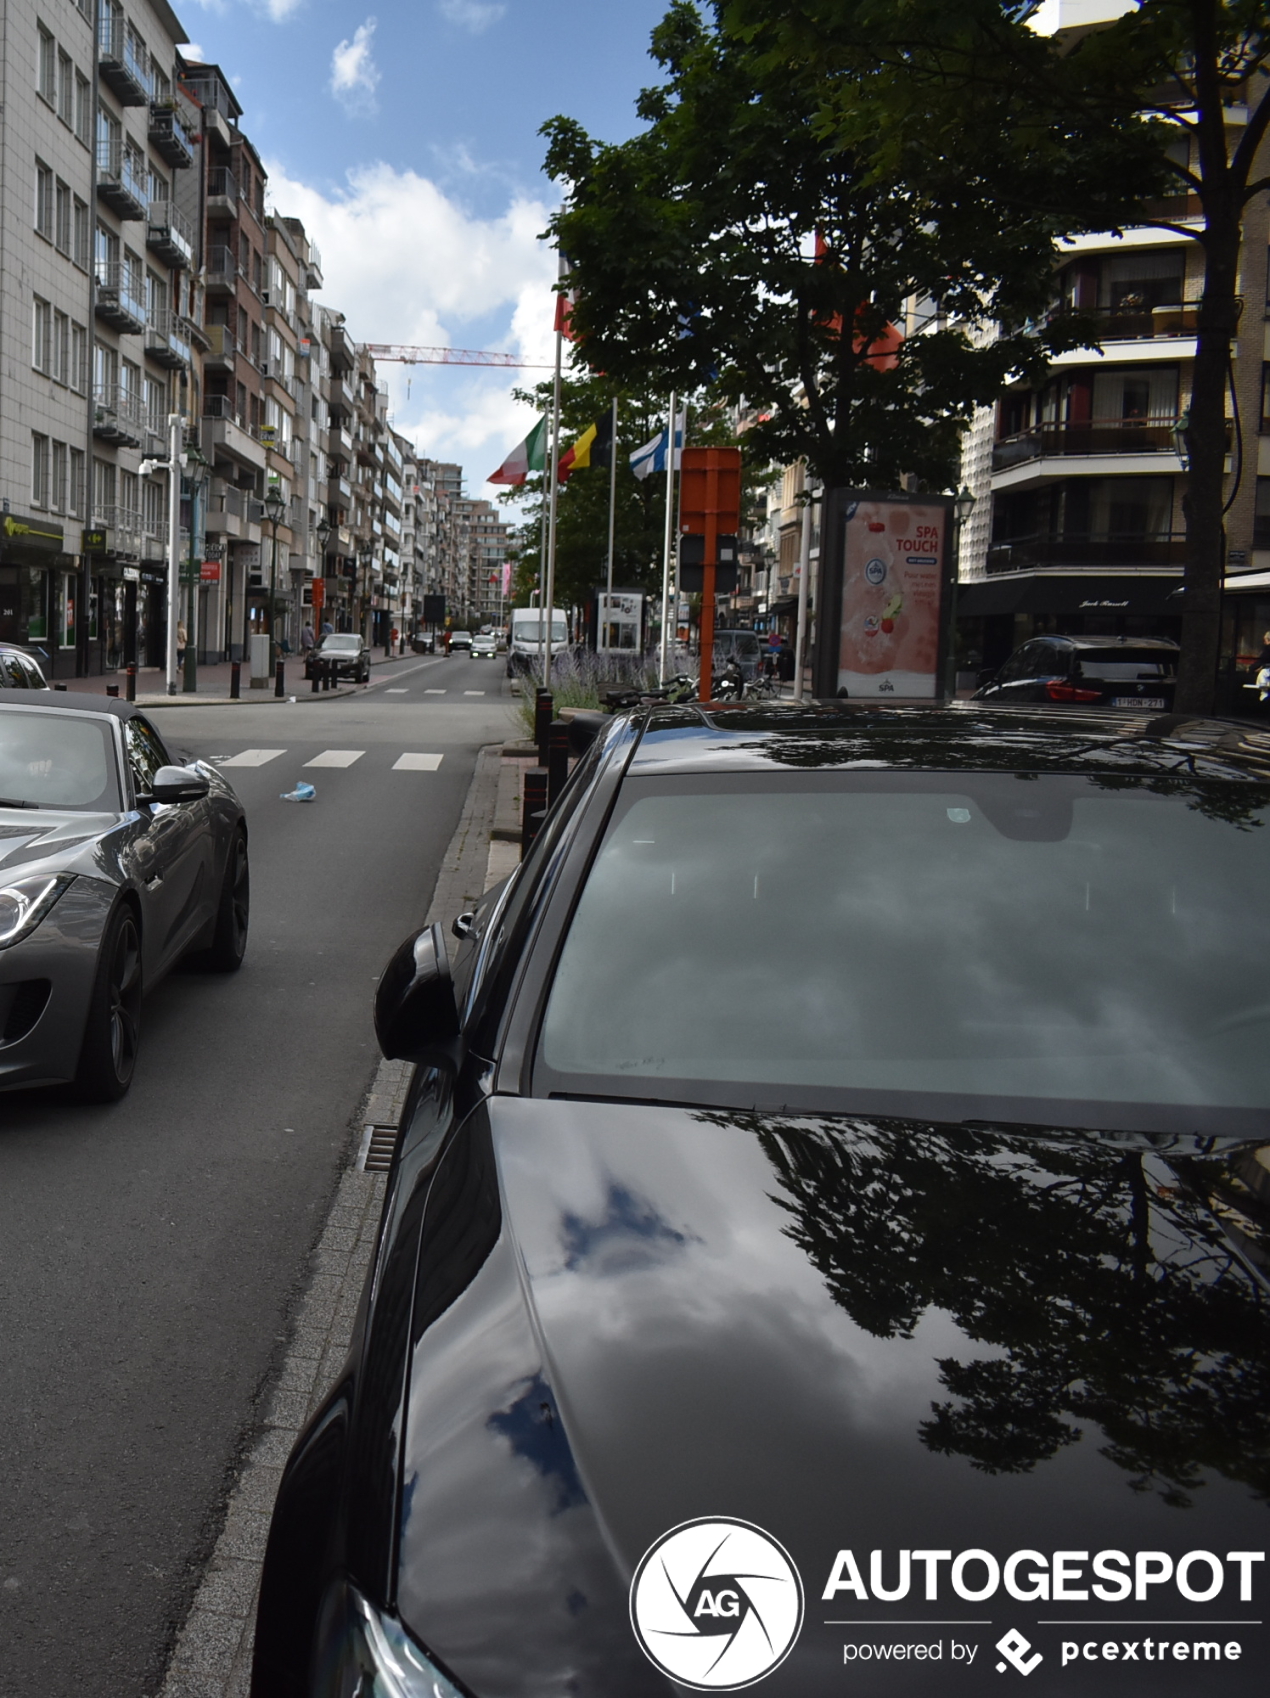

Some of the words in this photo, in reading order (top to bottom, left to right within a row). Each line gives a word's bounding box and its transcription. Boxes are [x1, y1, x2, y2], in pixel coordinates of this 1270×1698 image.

[916, 526, 938, 538] SPA
[896, 539, 938, 553] TOUCH
[878, 684, 894, 692] SPA
